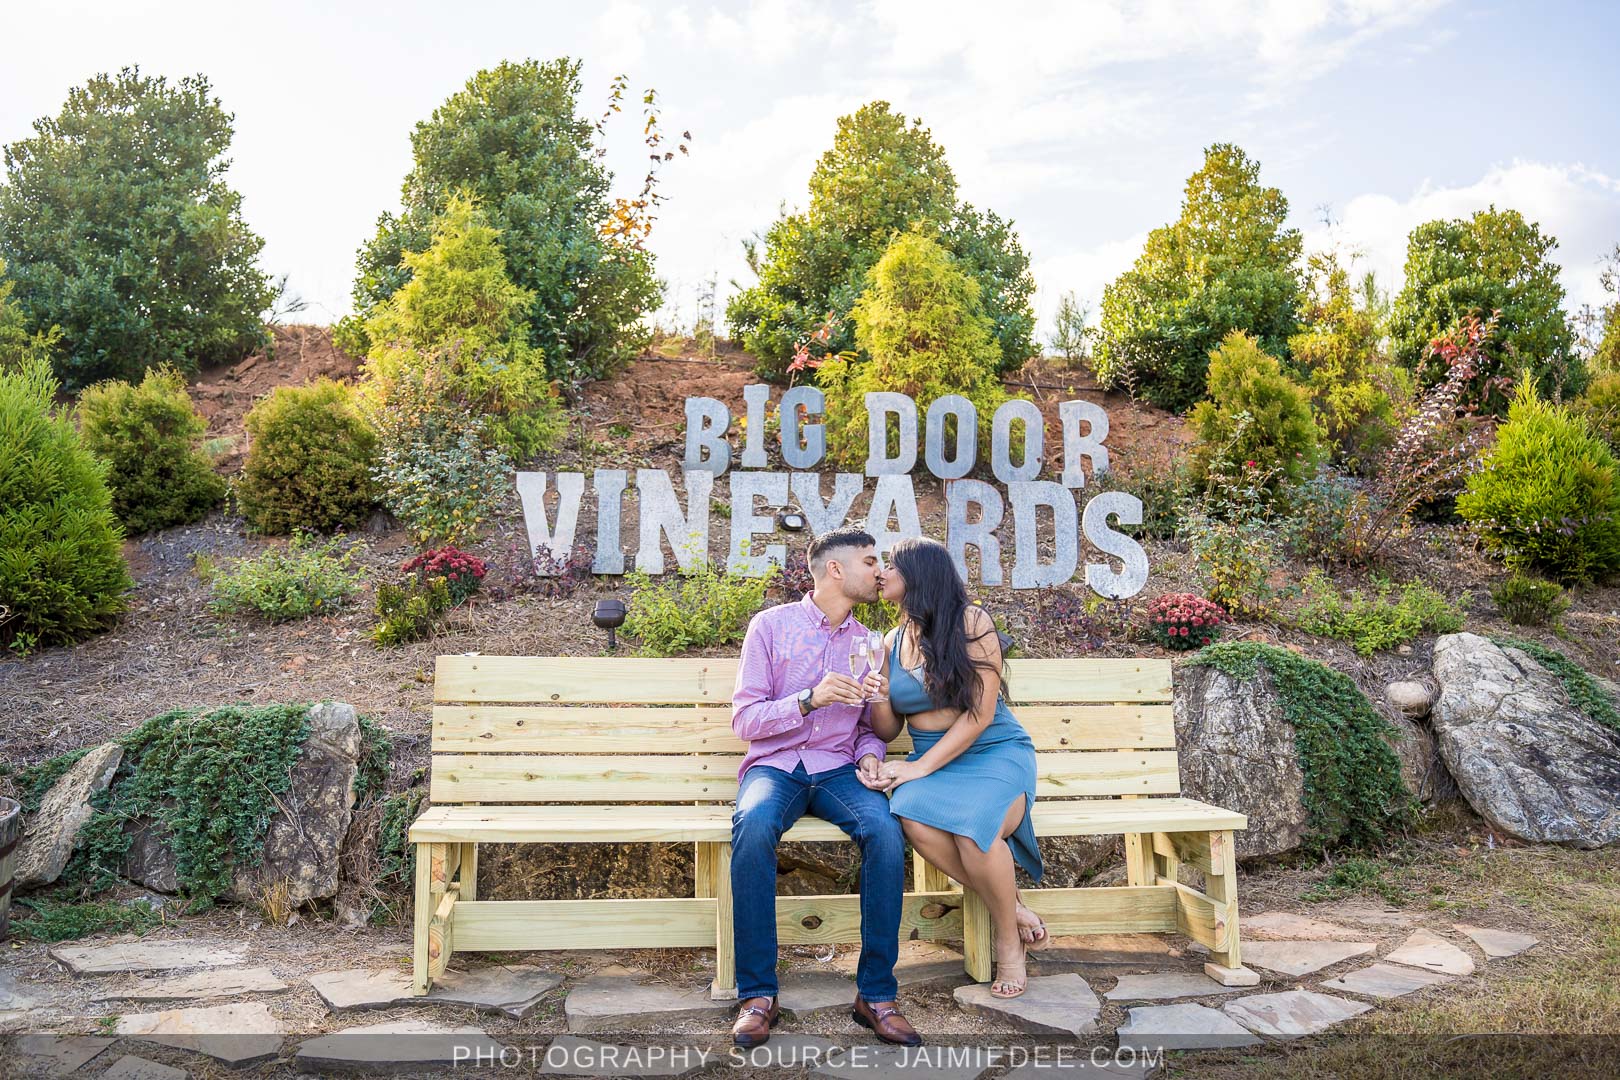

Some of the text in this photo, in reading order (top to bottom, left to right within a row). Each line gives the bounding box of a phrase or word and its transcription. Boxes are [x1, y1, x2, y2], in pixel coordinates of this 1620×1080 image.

[684, 383, 1110, 489] BIG DOOR
[516, 468, 1150, 600] VINEYARDS
